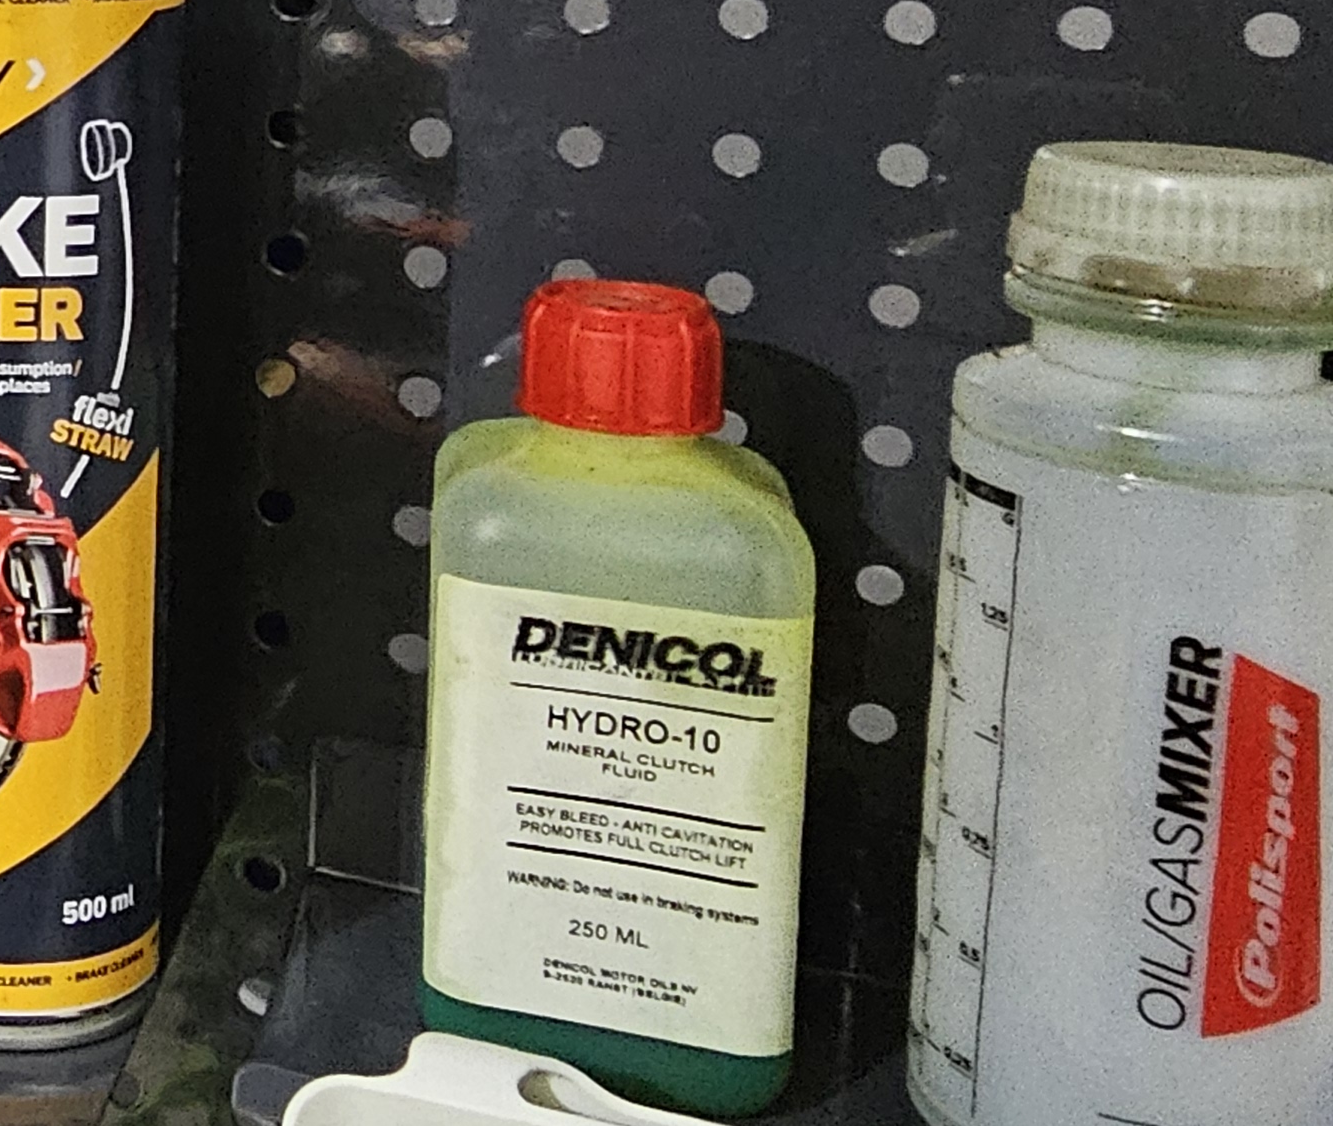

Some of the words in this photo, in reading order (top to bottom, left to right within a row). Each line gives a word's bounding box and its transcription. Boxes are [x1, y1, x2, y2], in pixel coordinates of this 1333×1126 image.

[72, 394, 133, 435] flexi
[50, 419, 134, 462] STRAW
[513, 616, 777, 695] DENICOL
[546, 704, 721, 754] HYDRO-10
[546, 739, 631, 765] MINERAL
[636, 753, 715, 778] CLUTCH
[601, 762, 657, 782] FLUID
[515, 802, 554, 819] EASY
[560, 809, 609, 827] BLEED
[621, 819, 657, 836] ANTI
[661, 827, 753, 854] CAVITATION
[519, 820, 603, 844] PROMOTES
[608, 833, 644, 852] FULL
[649, 841, 711, 863] CLUTCH
[715, 855, 746, 870] LIFT
[1238, 704, 1300, 994] Polisport
[62, 897, 106, 926] 500
[111, 883, 134, 914] ml
[507, 870, 569, 891] WARNING:
[573, 880, 589, 895] Do
[593, 883, 612, 899] not
[642, 892, 654, 905] in
[569, 919, 608, 941] 250
[615, 926, 649, 949] ML
